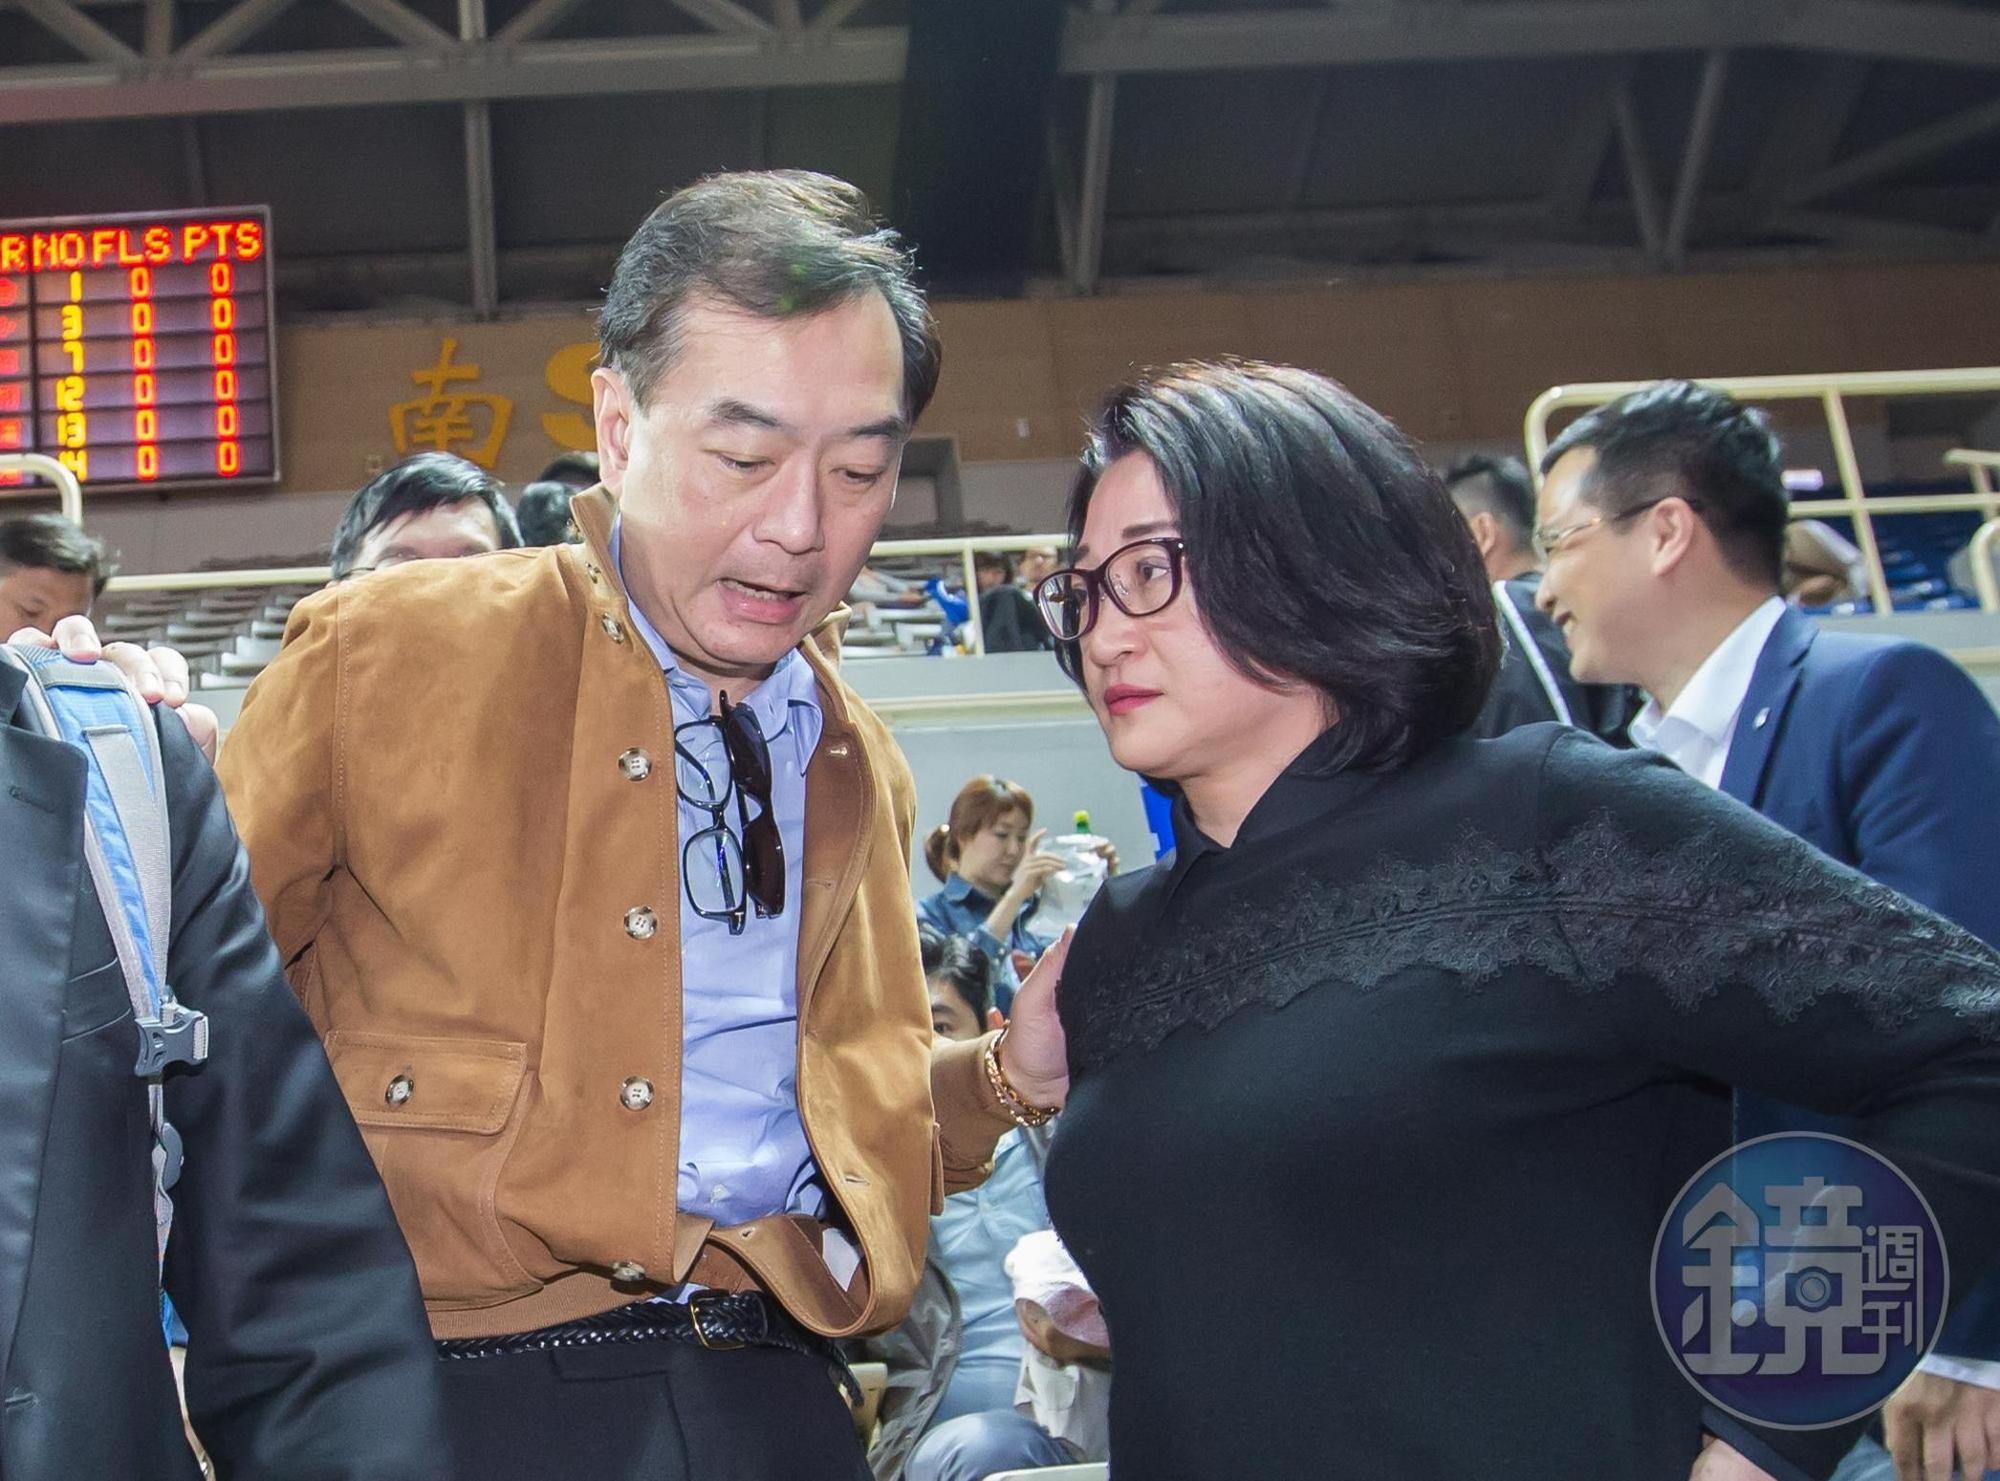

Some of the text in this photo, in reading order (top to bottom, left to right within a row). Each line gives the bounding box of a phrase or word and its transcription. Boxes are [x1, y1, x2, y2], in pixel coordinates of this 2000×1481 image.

[32, 232, 84, 268] NO
[92, 229, 172, 267] FLS
[183, 223, 262, 260] PTS
[70, 262, 231, 302] 1 0 0
[61, 298, 234, 340] 3 0 0
[133, 338, 153, 369] 0
[214, 333, 235, 365] 0
[134, 374, 155, 405] 0
[215, 369, 236, 400] 0
[388, 337, 512, 469] 南
[136, 409, 157, 441] 0
[217, 405, 237, 436] 0
[137, 445, 158, 478] 0
[218, 441, 239, 473] 0
